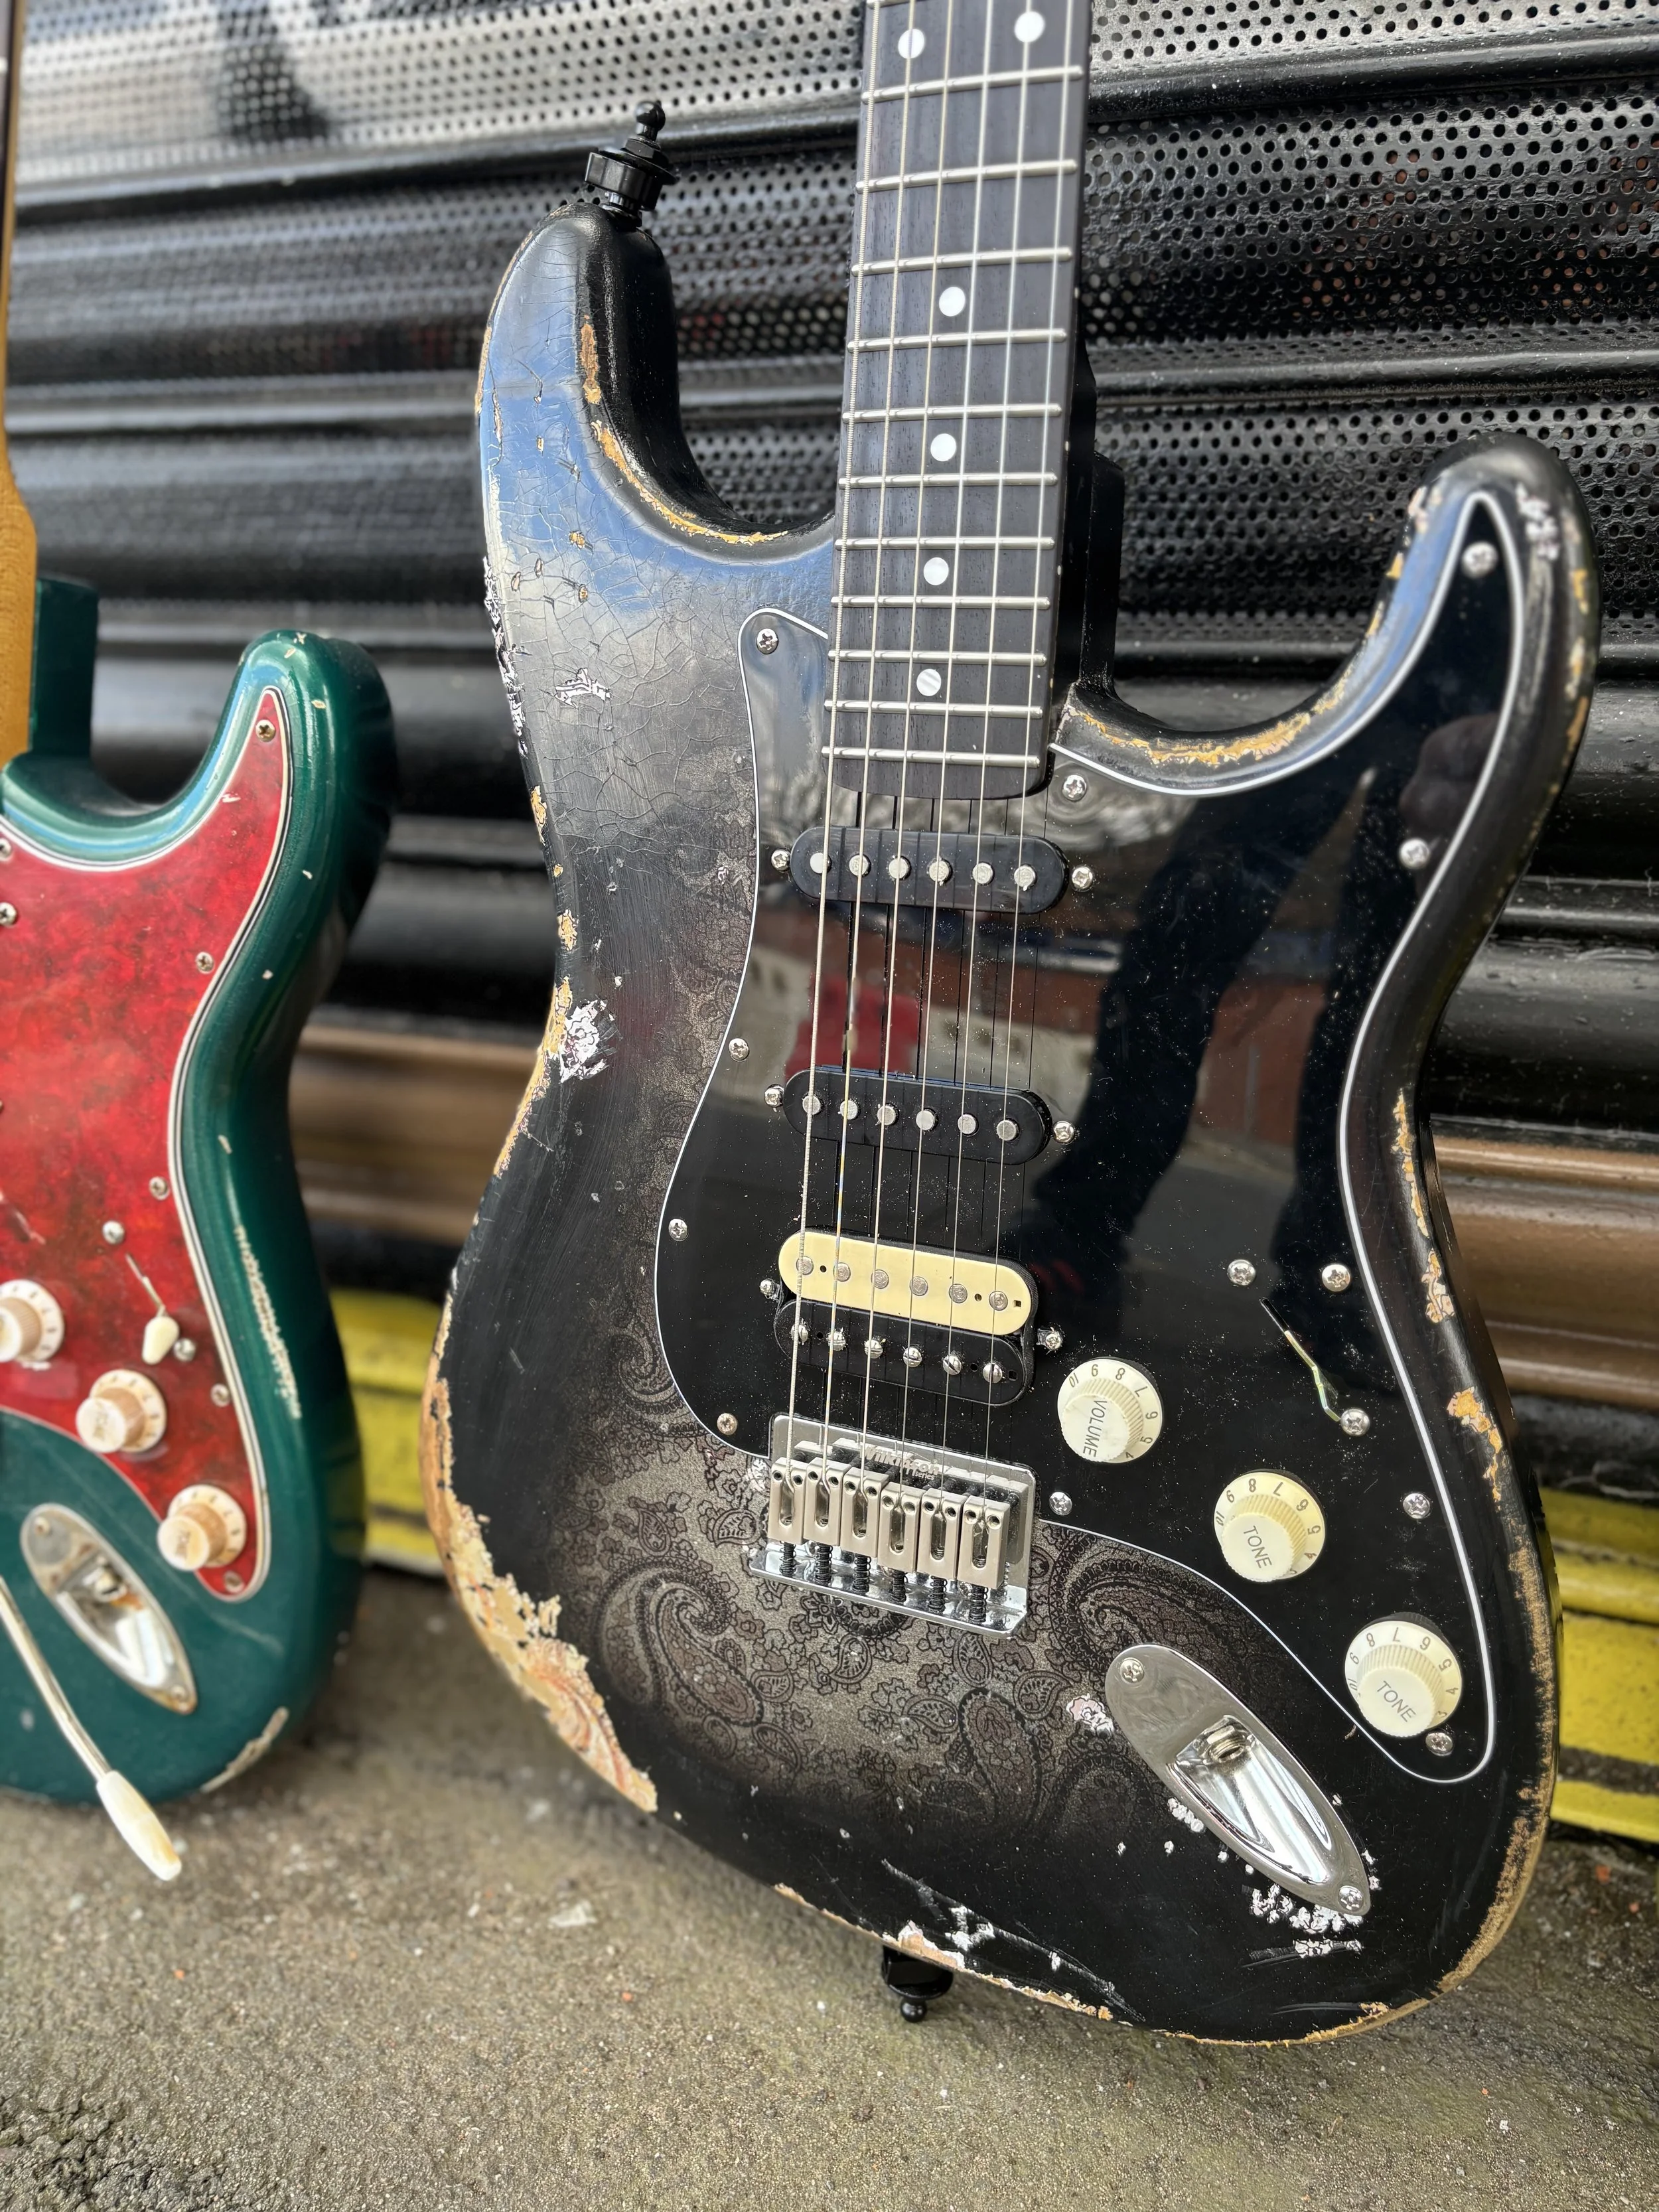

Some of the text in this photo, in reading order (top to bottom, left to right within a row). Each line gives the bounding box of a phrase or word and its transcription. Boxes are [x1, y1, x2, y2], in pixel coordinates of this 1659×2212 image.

[1115, 1367, 1125, 1380] 8
[1083, 1400, 1108, 1457] VOLUME
[915, 1471, 935, 1481] series
[1248, 1478, 1257, 1493] 8
[1243, 1525, 1273, 1568] TONE
[1366, 1633, 1375, 1647] 8
[1377, 1680, 1416, 1723] TONE
